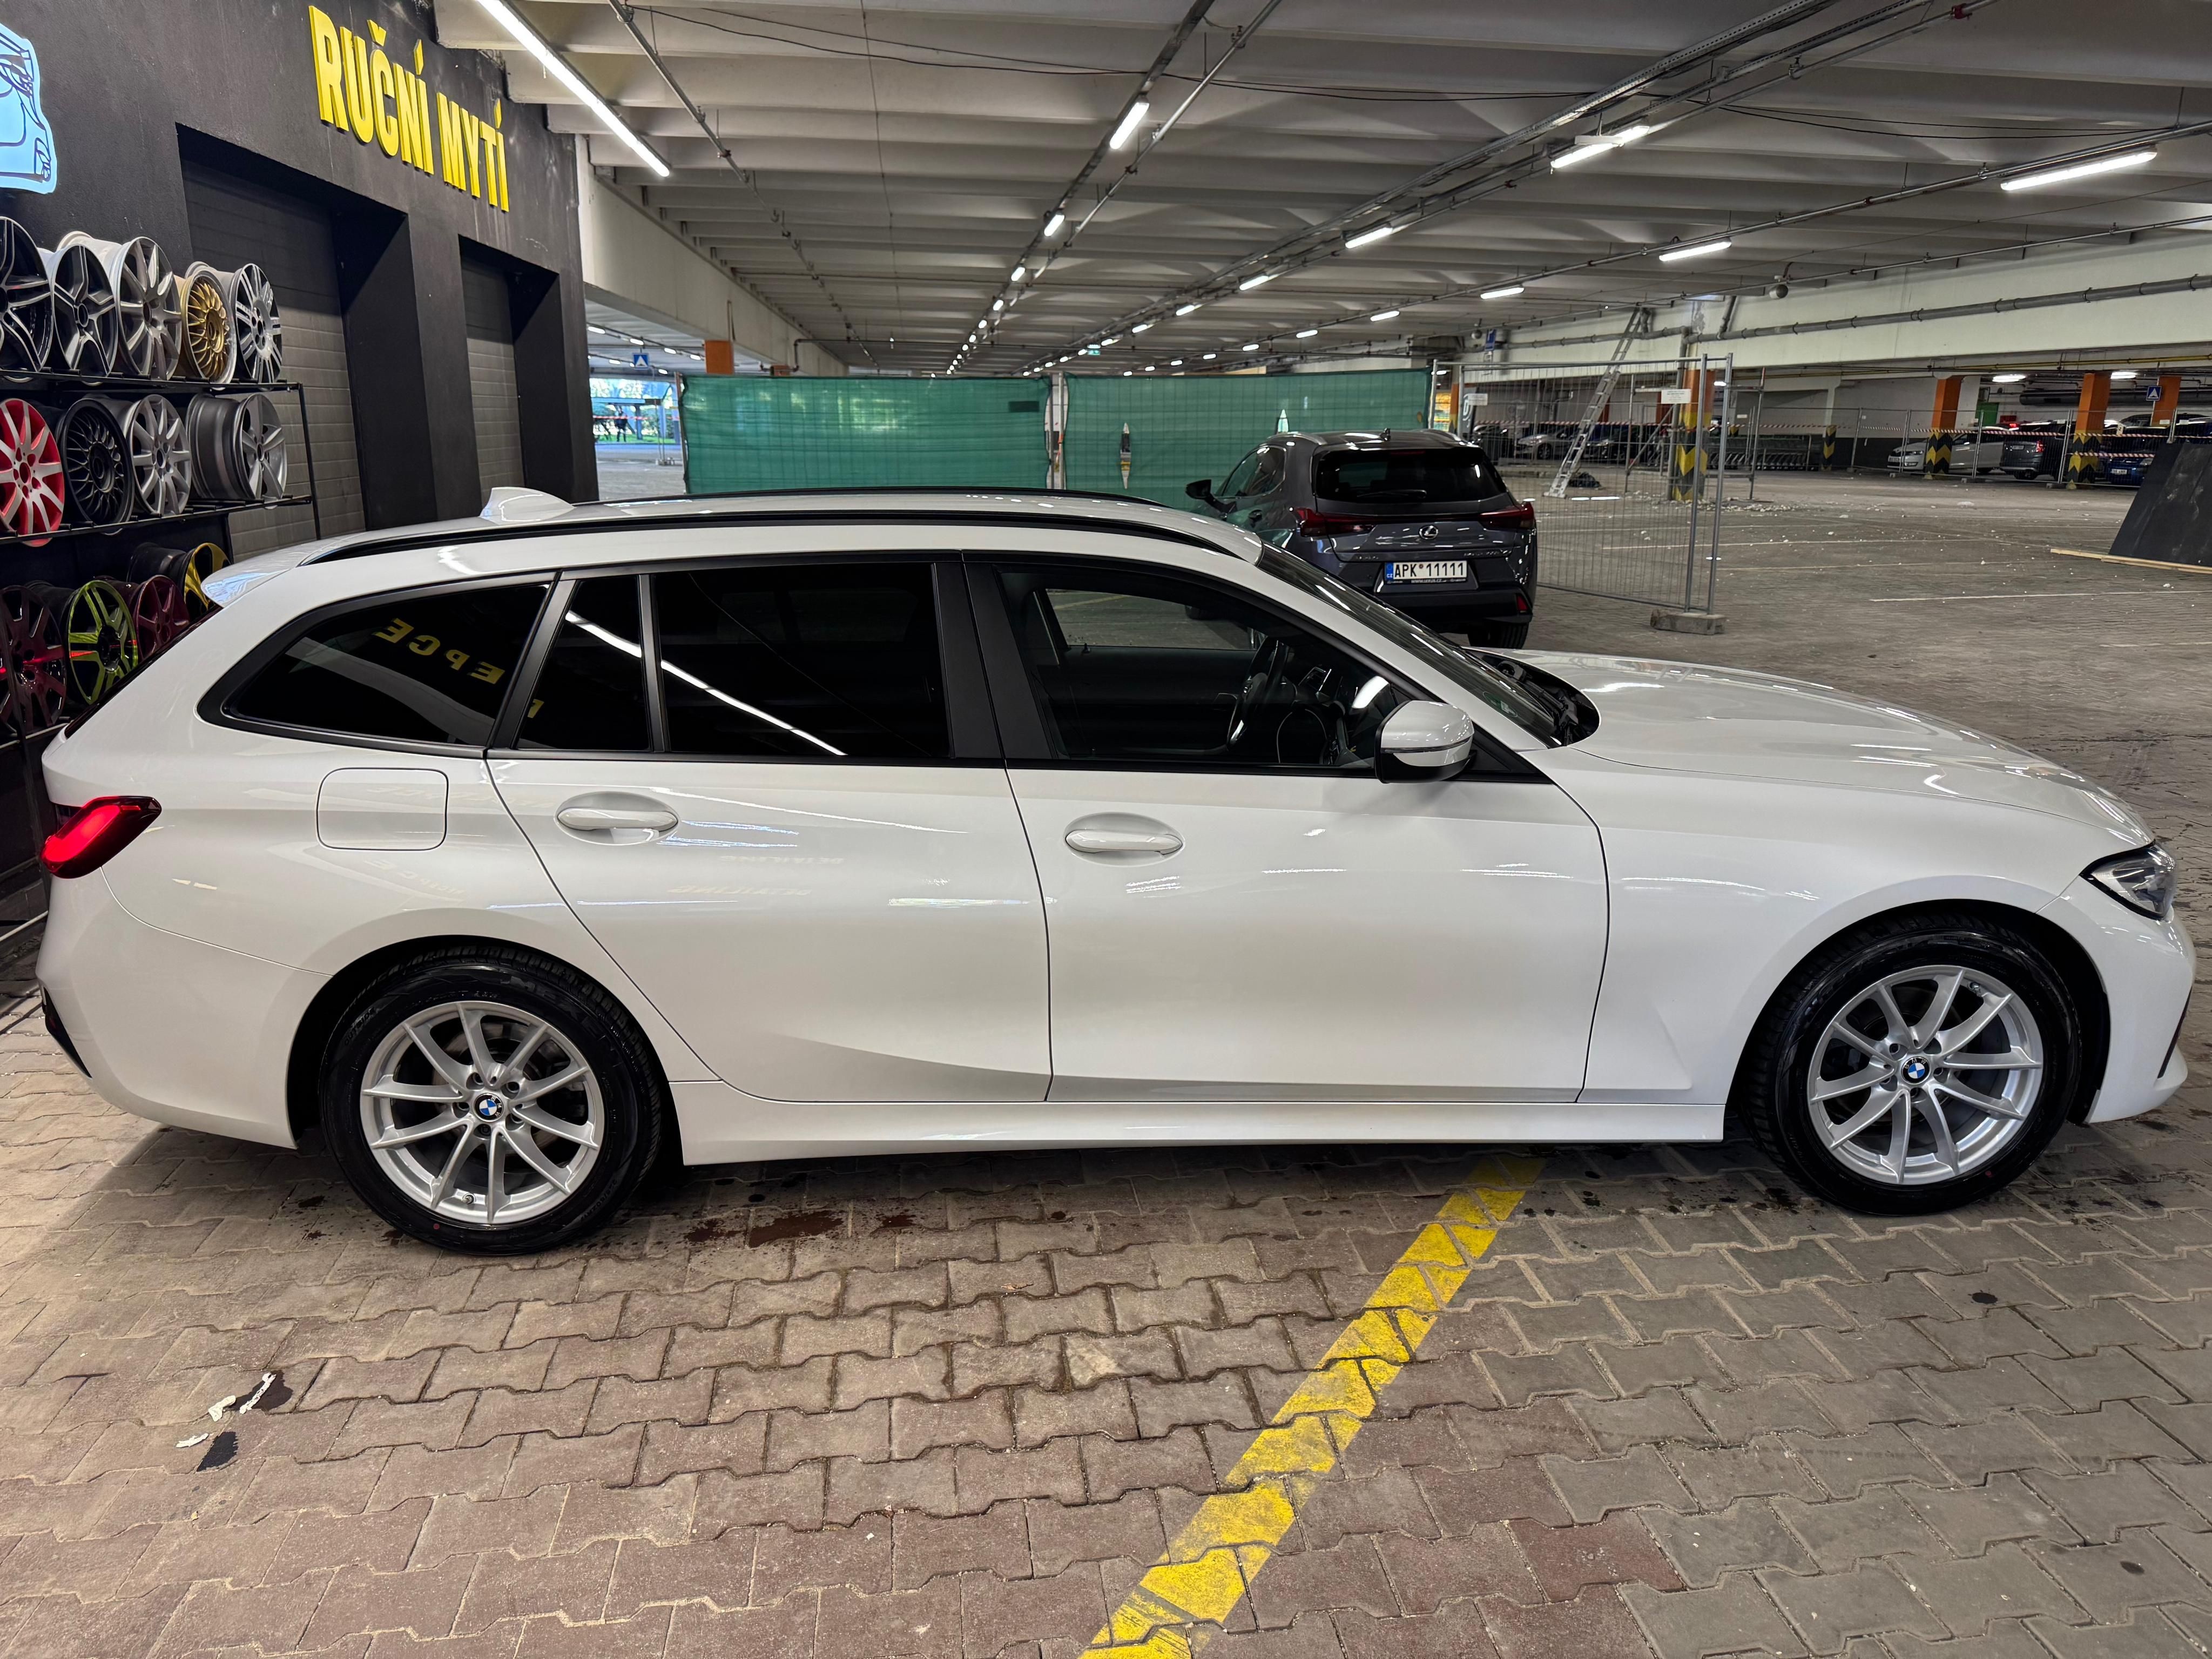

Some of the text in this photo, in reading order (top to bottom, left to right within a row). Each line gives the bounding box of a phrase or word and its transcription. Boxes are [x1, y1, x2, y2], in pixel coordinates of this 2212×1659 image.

[309, 5, 509, 212] RUČNÍ MYTÍ
[1394, 562, 1464, 578] APK 11111
[1904, 1058, 1927, 1069] BMW
